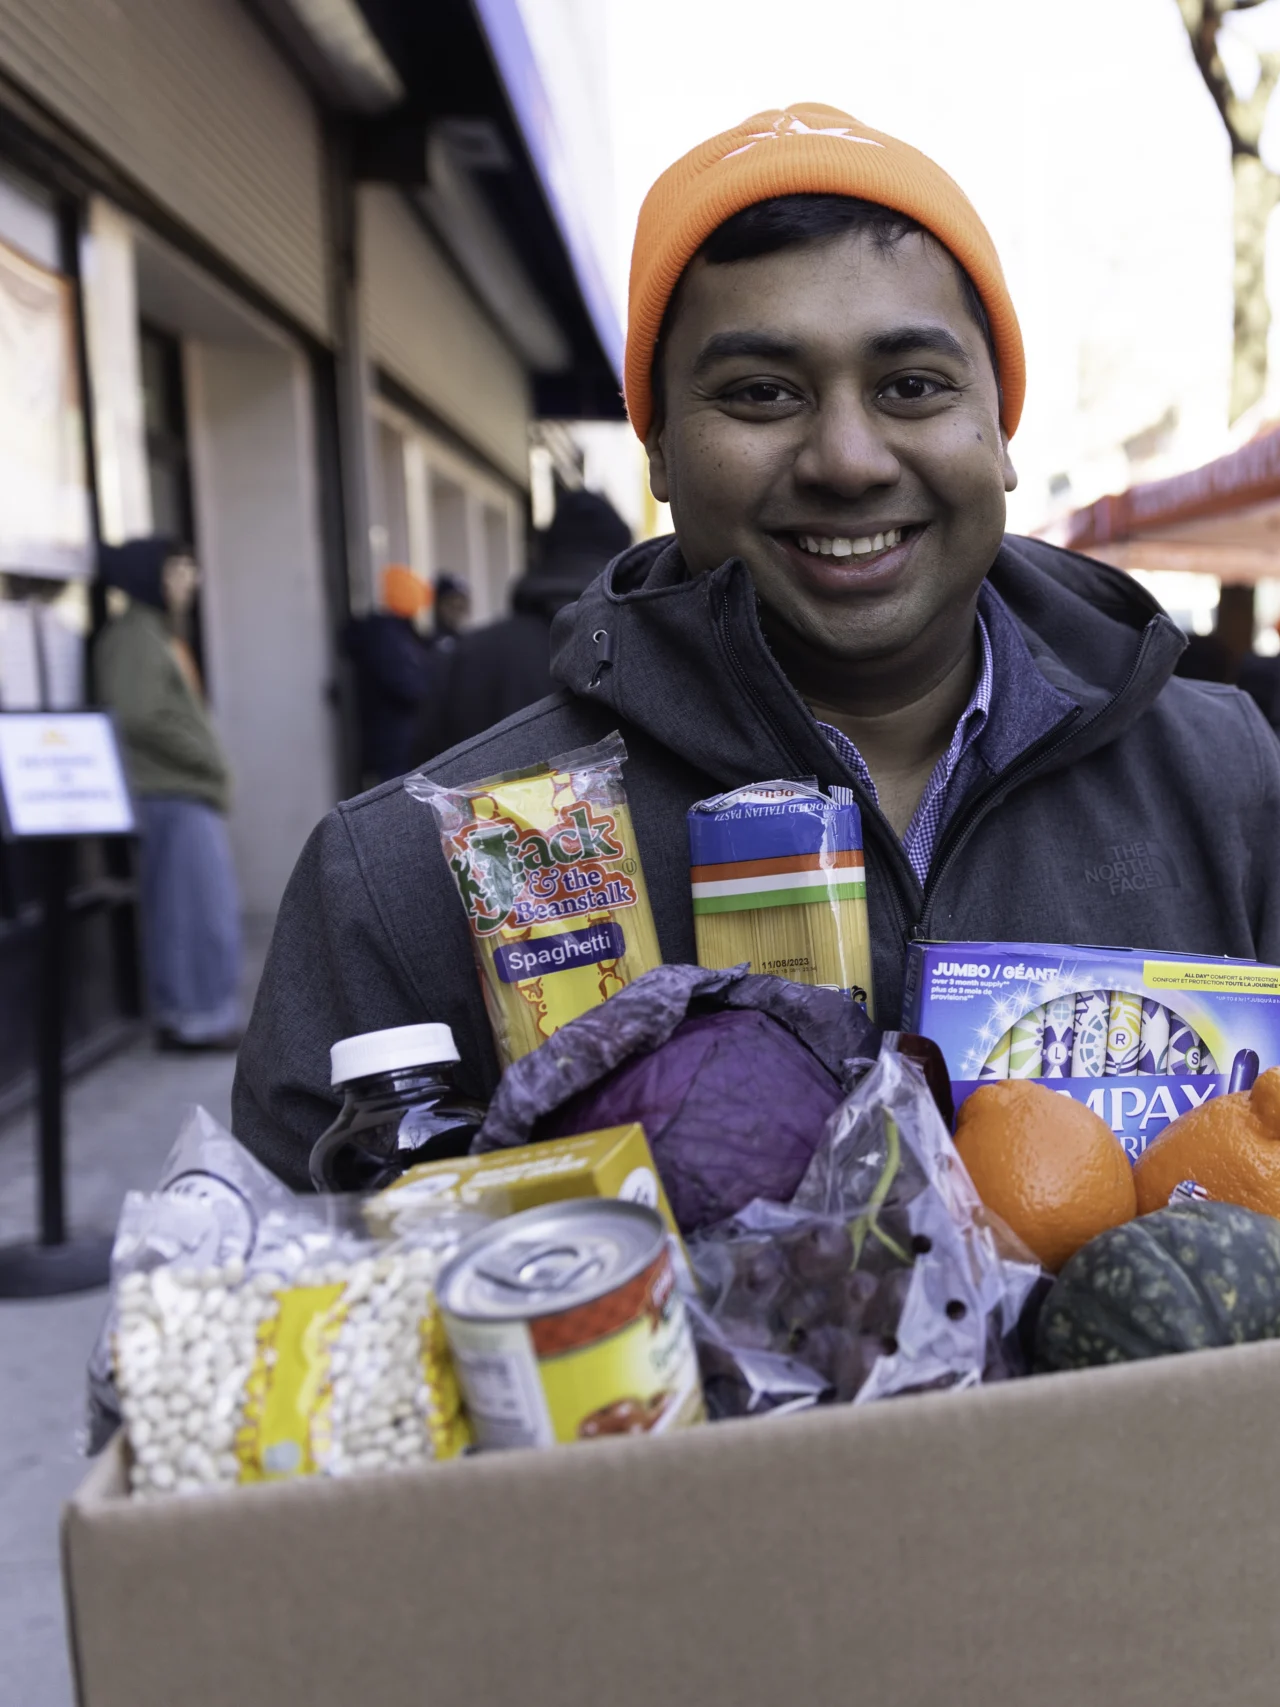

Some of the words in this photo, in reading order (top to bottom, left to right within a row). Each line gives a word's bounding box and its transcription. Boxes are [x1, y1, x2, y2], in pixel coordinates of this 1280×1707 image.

[745, 807, 786, 820] ITALIAN
[1110, 841, 1148, 861] THE
[467, 808, 619, 932] Jack
[1084, 856, 1153, 884] NORTH
[528, 867, 559, 899] &
[562, 868, 601, 892] the
[1108, 872, 1158, 896] FACE
[514, 881, 632, 924] Beanstalk
[508, 931, 612, 971] Spaghetti
[762, 957, 810, 970] 11/08/2023
[932, 962, 991, 978] JUMBO
[992, 964, 1002, 980] /
[1002, 963, 1058, 980] GÉANT
[1152, 976, 1181, 984] CONFORT
[931, 986, 948, 994] plus
[948, 986, 958, 994] de
[965, 987, 983, 995] mois
[1115, 1033, 1126, 1045] R
[1055, 1047, 1061, 1060] L
[1191, 1051, 1200, 1065] S
[1055, 1083, 1216, 1132] MPAX
